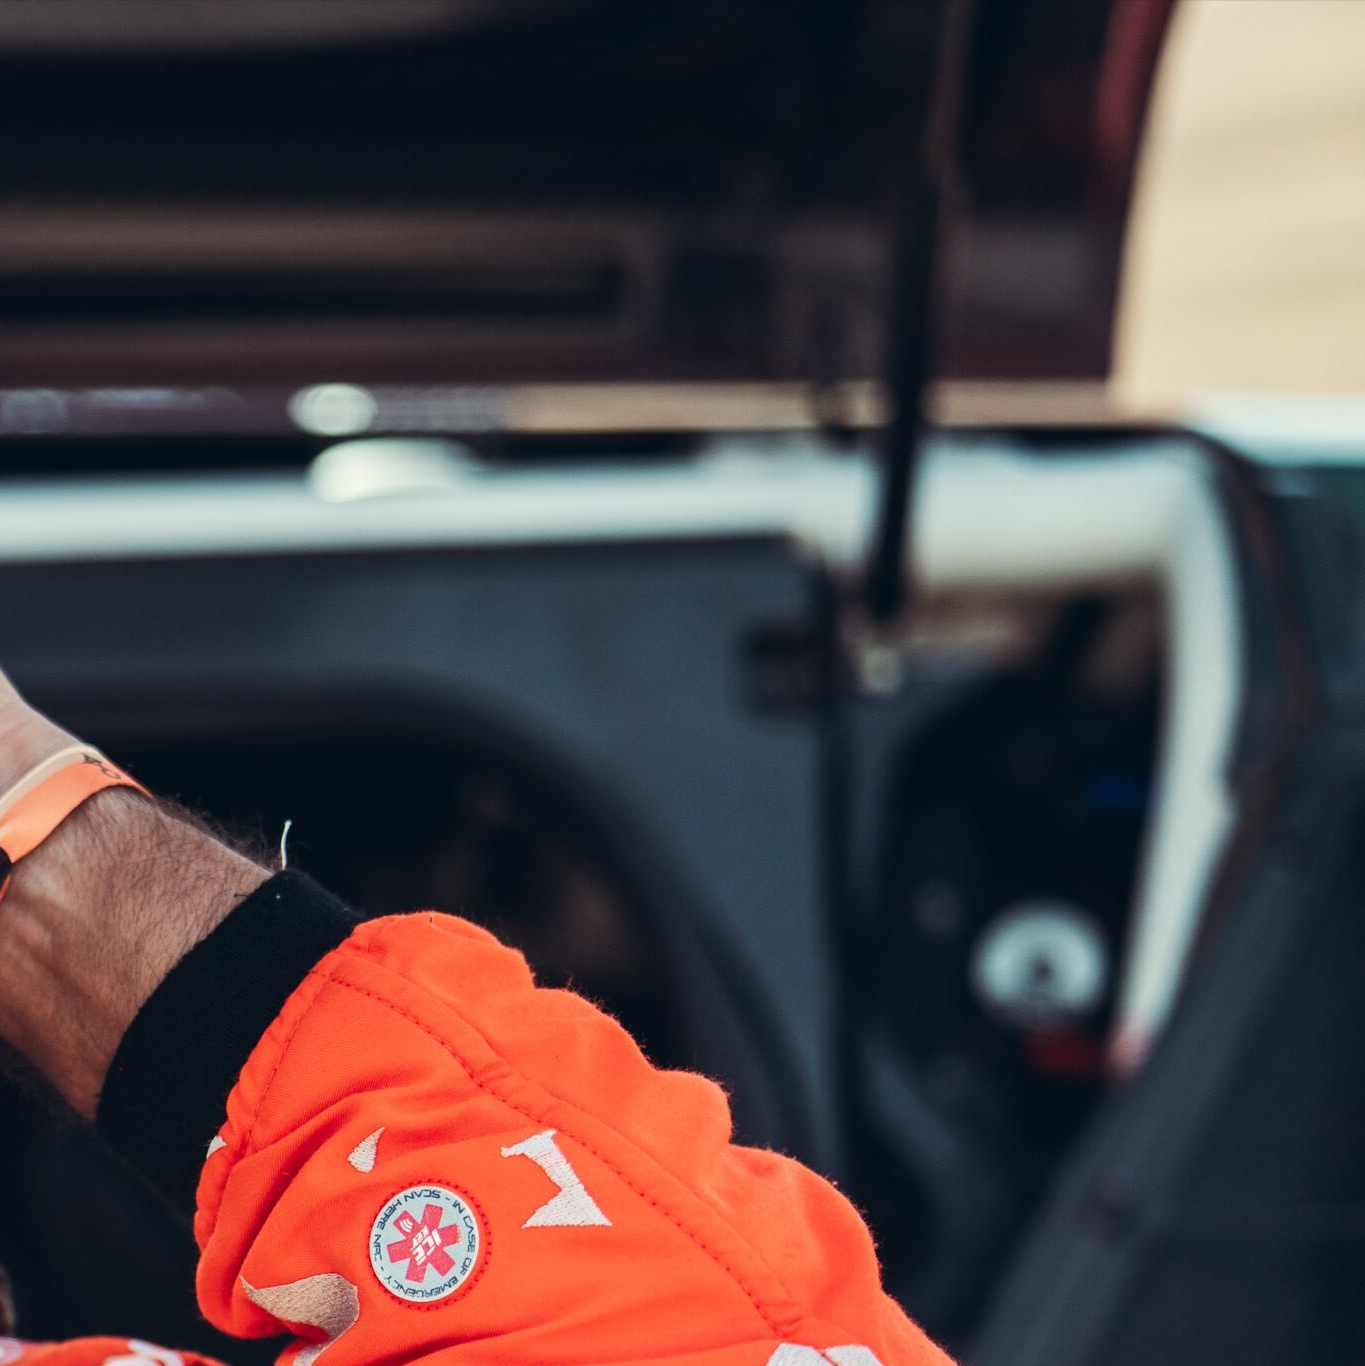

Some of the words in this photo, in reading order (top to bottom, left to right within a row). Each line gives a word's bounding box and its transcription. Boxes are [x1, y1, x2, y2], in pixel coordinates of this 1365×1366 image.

[403, 1189, 441, 1202] SCAN
[377, 1198, 403, 1230] HERE
[412, 1228, 441, 1266] ICE
[462, 1215, 476, 1252] CASE
[460, 1257, 472, 1276] OF
[384, 1275, 459, 1298] EMERGENCY
